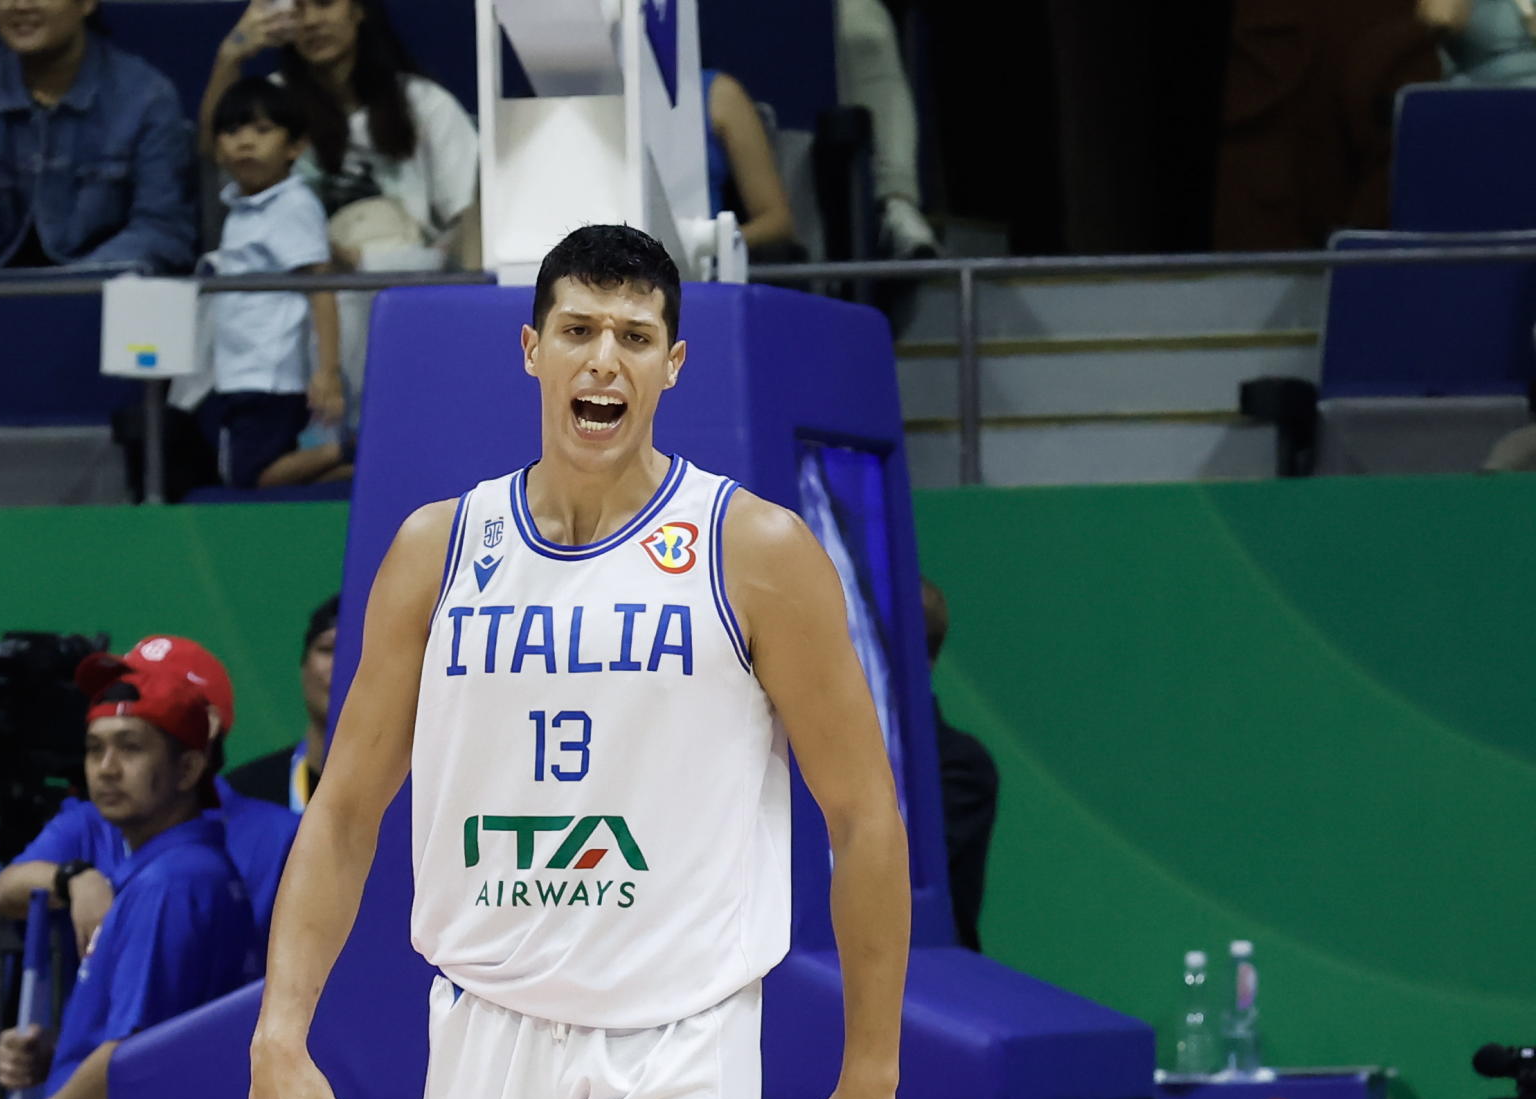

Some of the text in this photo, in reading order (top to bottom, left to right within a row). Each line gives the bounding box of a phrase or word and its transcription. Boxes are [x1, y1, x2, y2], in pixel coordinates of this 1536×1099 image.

[446, 603, 694, 676] ITALIA
[529, 710, 592, 782] 13
[464, 814, 650, 871] ITA
[475, 880, 635, 908] AIRWAYS
